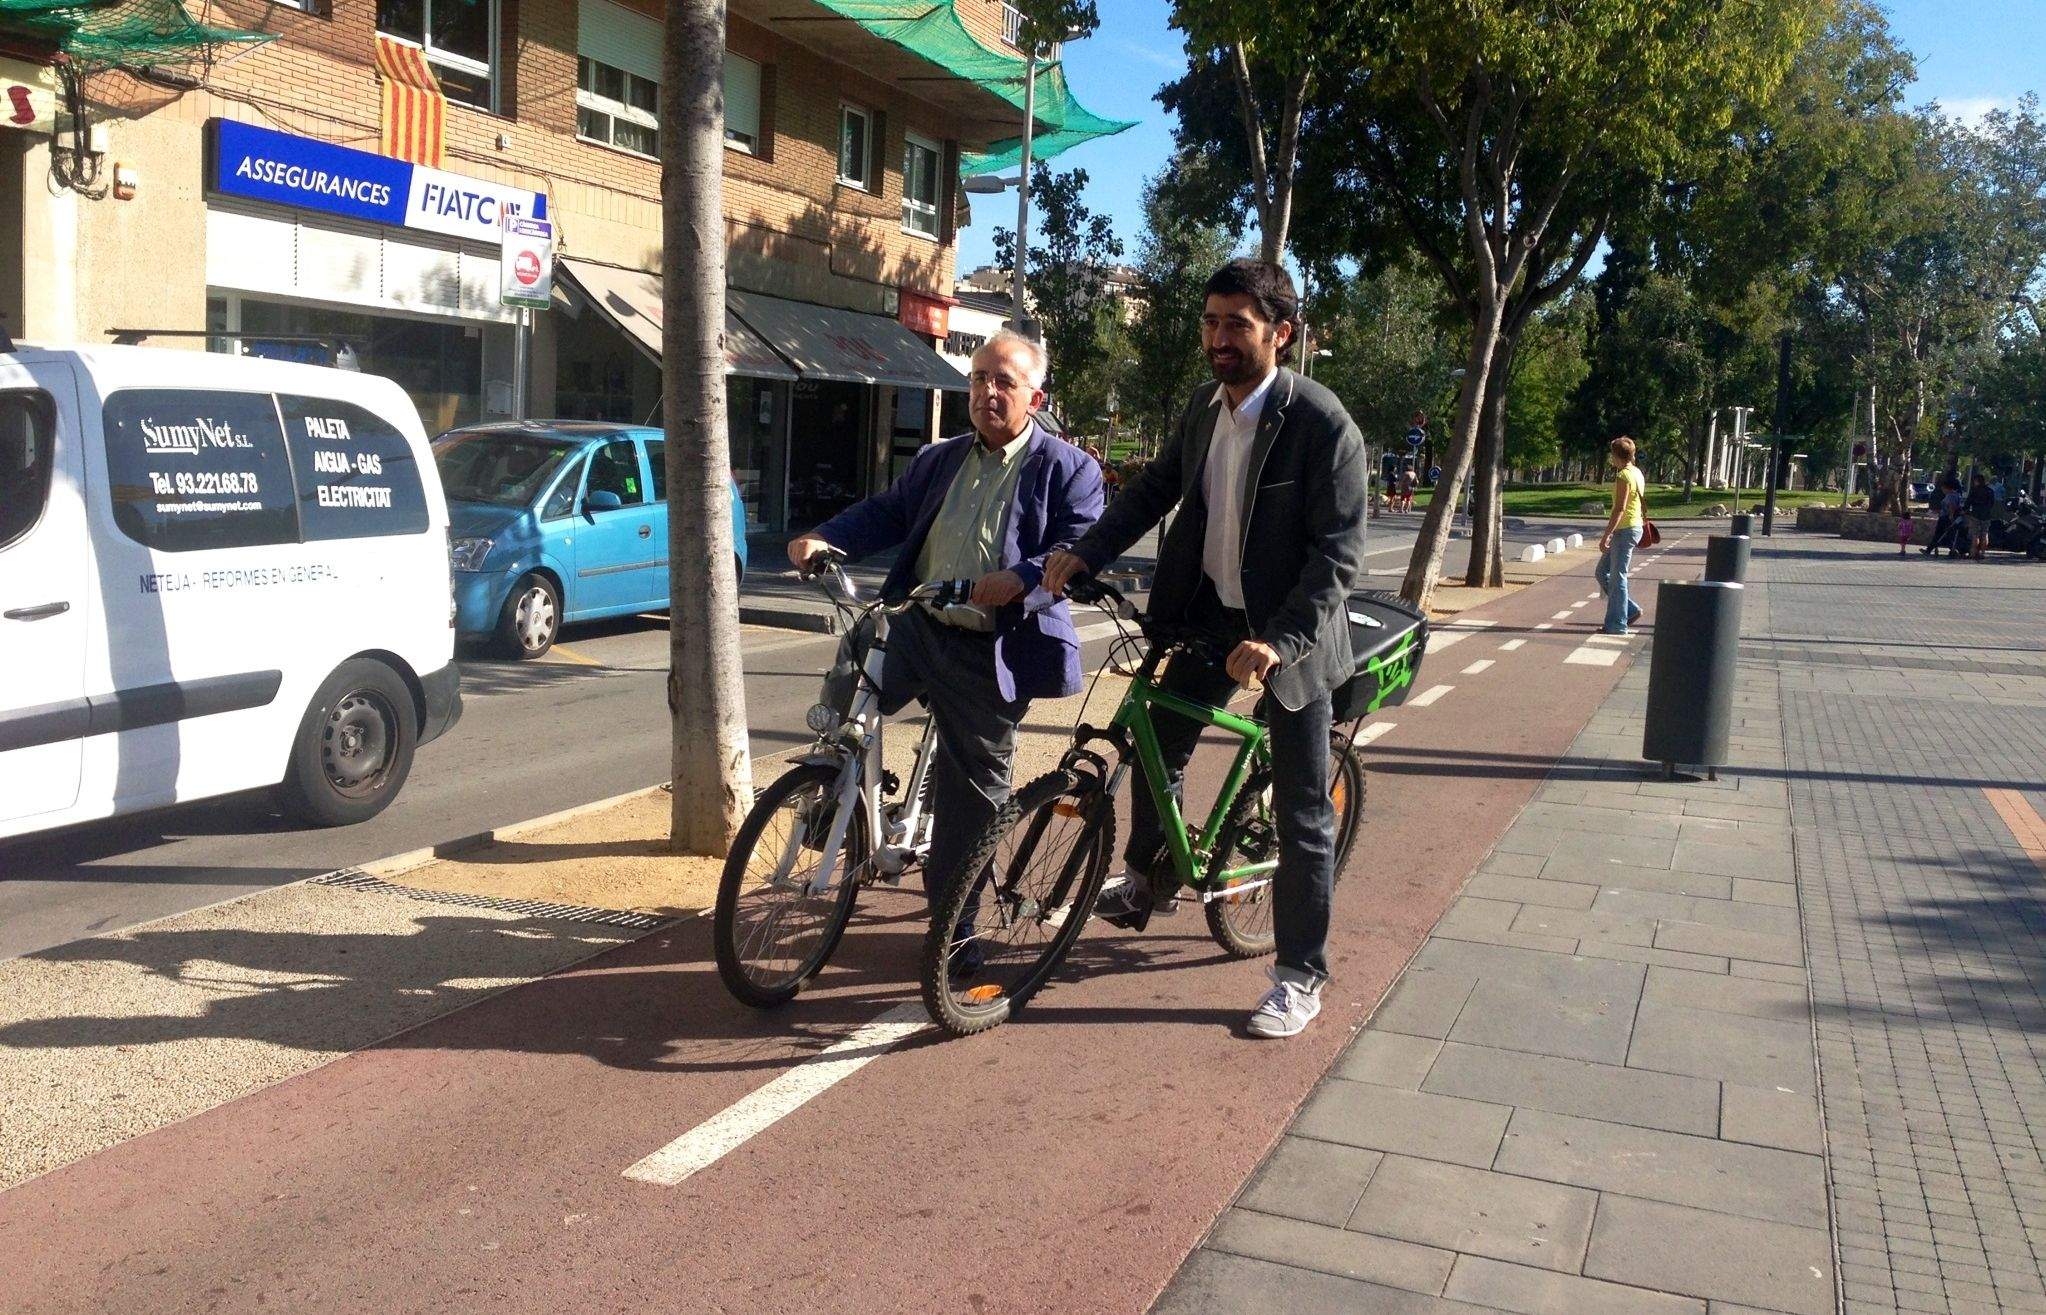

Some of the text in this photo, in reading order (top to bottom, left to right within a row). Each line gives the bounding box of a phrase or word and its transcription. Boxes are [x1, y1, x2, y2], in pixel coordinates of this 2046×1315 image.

[236, 155, 496, 225] ASSEGURANCES FIATC
[140, 417, 234, 455] SumyNet
[304, 416, 350, 440] PALETA
[314, 450, 350, 473] AIGUA
[357, 453, 382, 475] GAS
[148, 472, 175, 494] Tel.
[156, 500, 262, 514] sumynet@sumynet.com
[317, 485, 392, 508] ELECTRICITAT
[202, 568, 269, 589] REFORMES
[271, 567, 287, 585] EN
